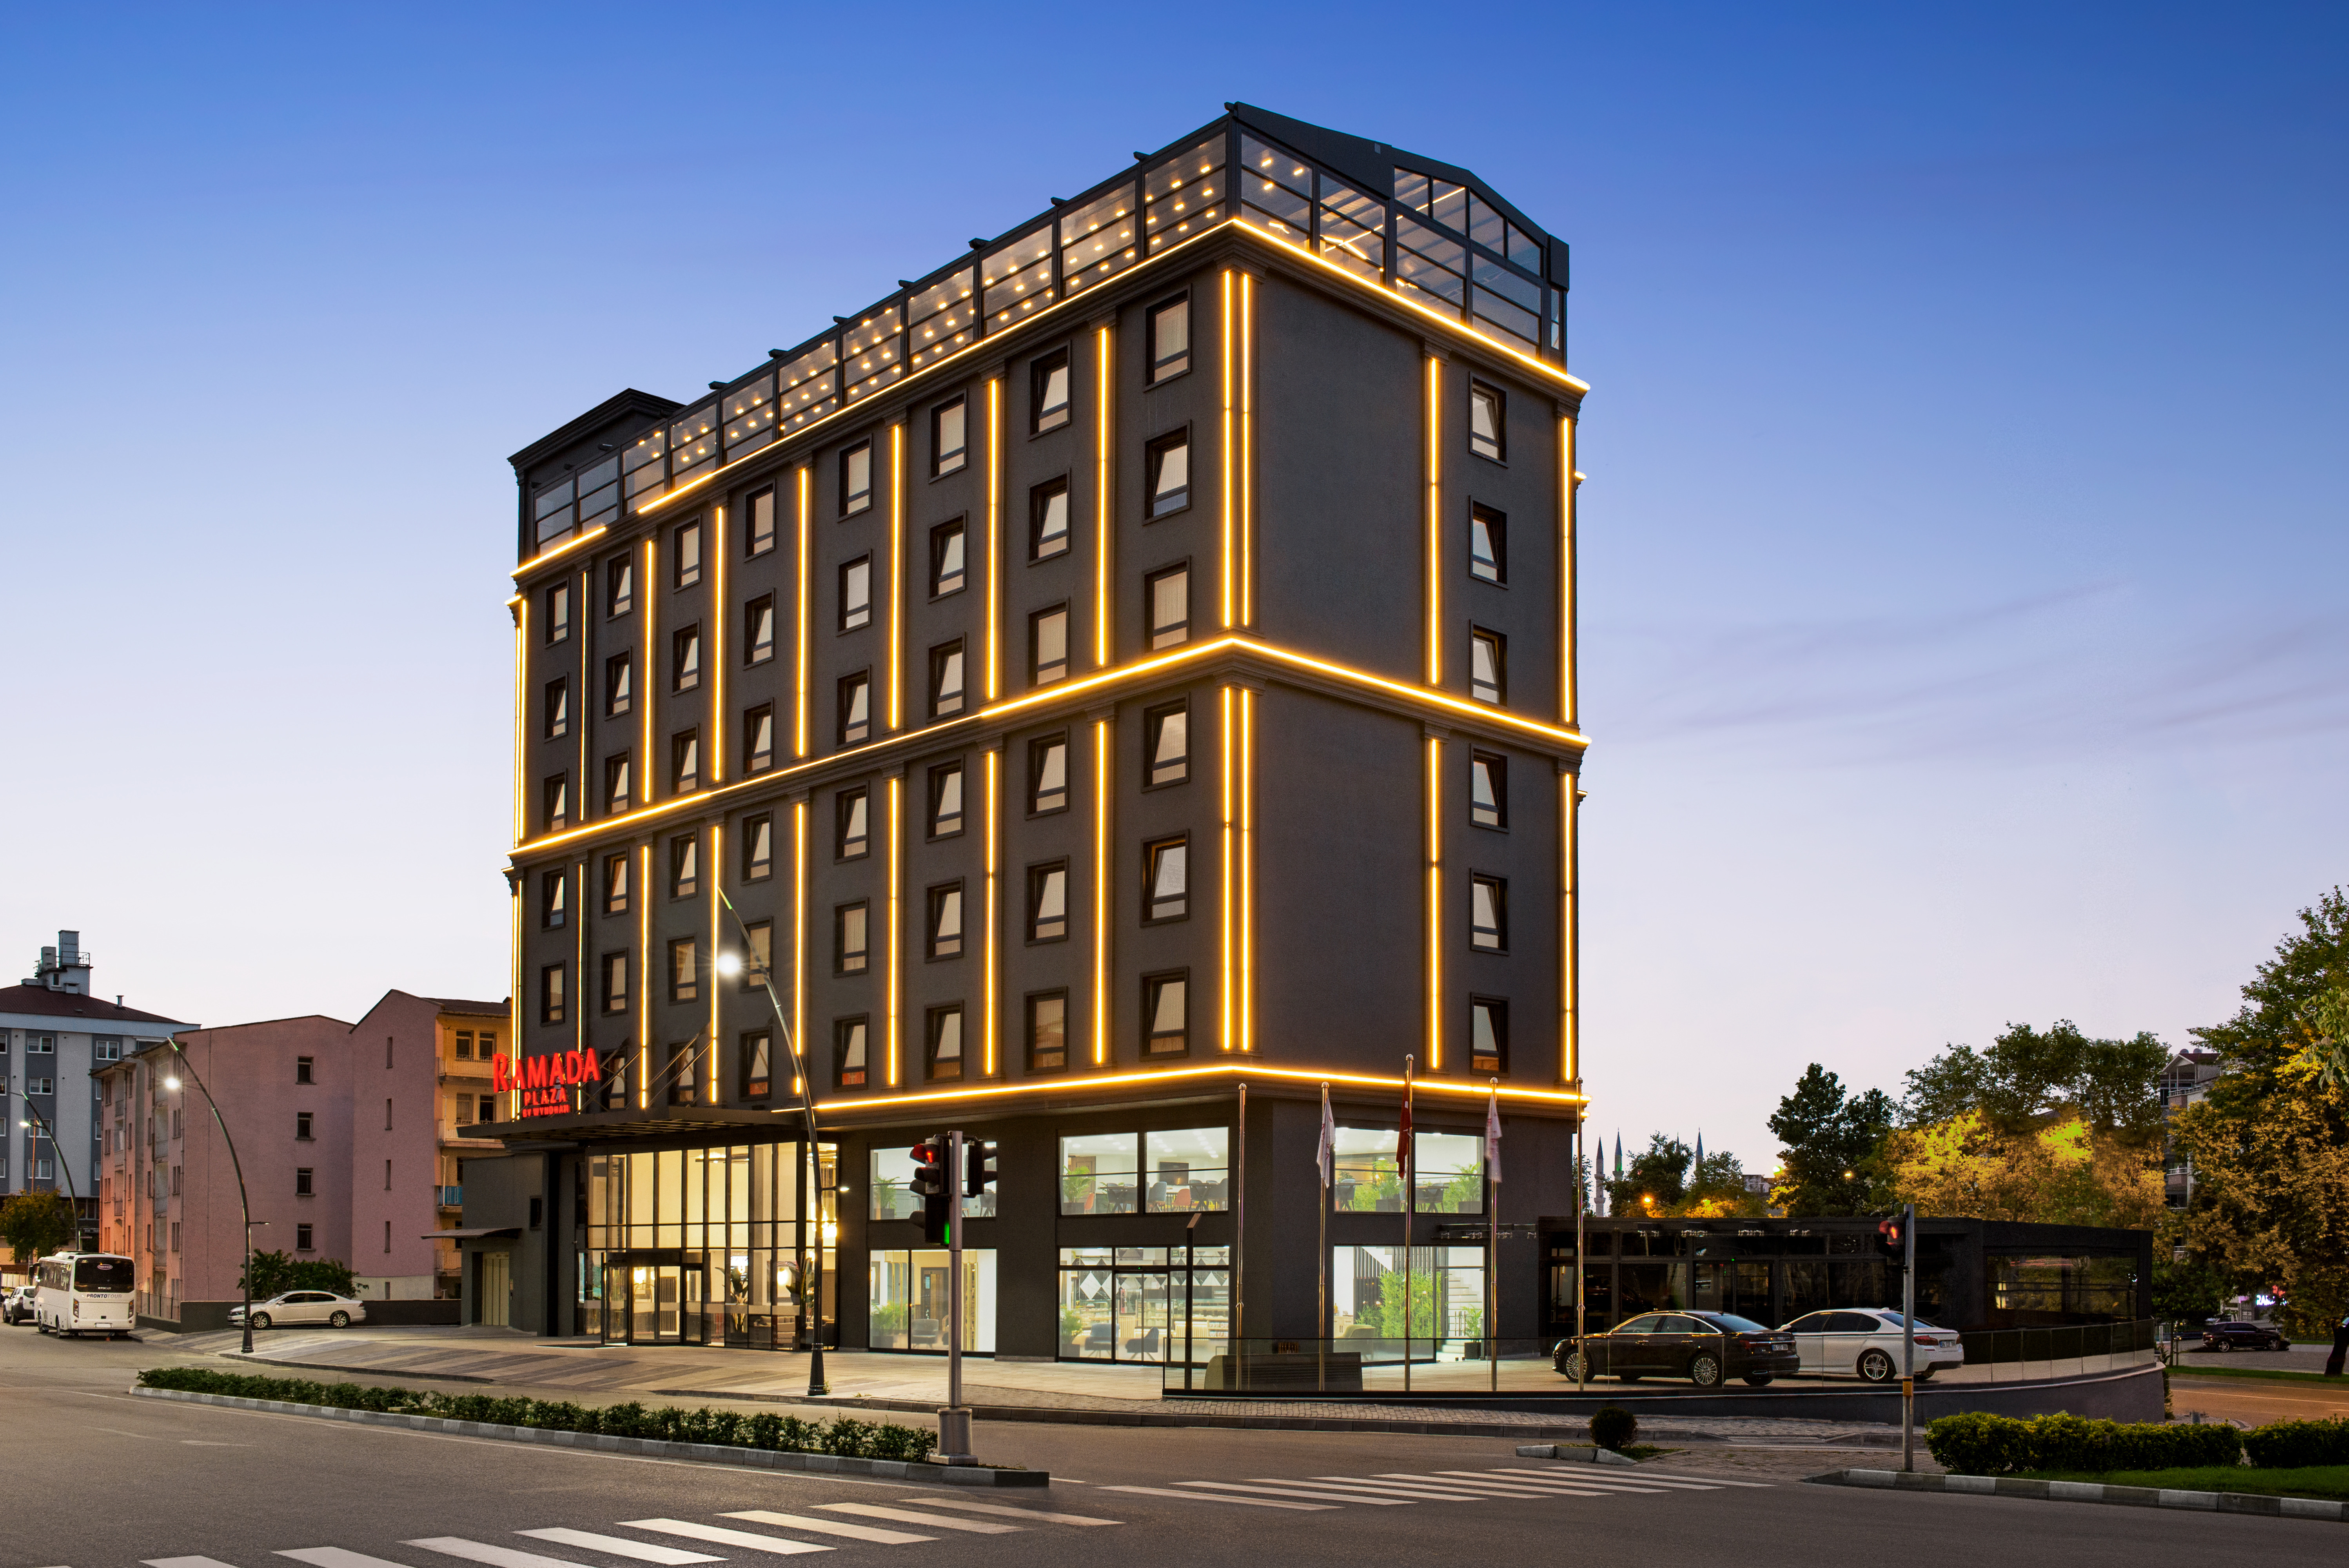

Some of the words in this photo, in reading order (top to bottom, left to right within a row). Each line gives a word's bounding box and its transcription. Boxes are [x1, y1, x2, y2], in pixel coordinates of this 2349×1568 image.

[493, 1048, 601, 1093] RAMADA
[524, 1087, 567, 1106] PLAZA
[523, 1109, 532, 1118] BY
[533, 1104, 570, 1116] WYNDHAM
